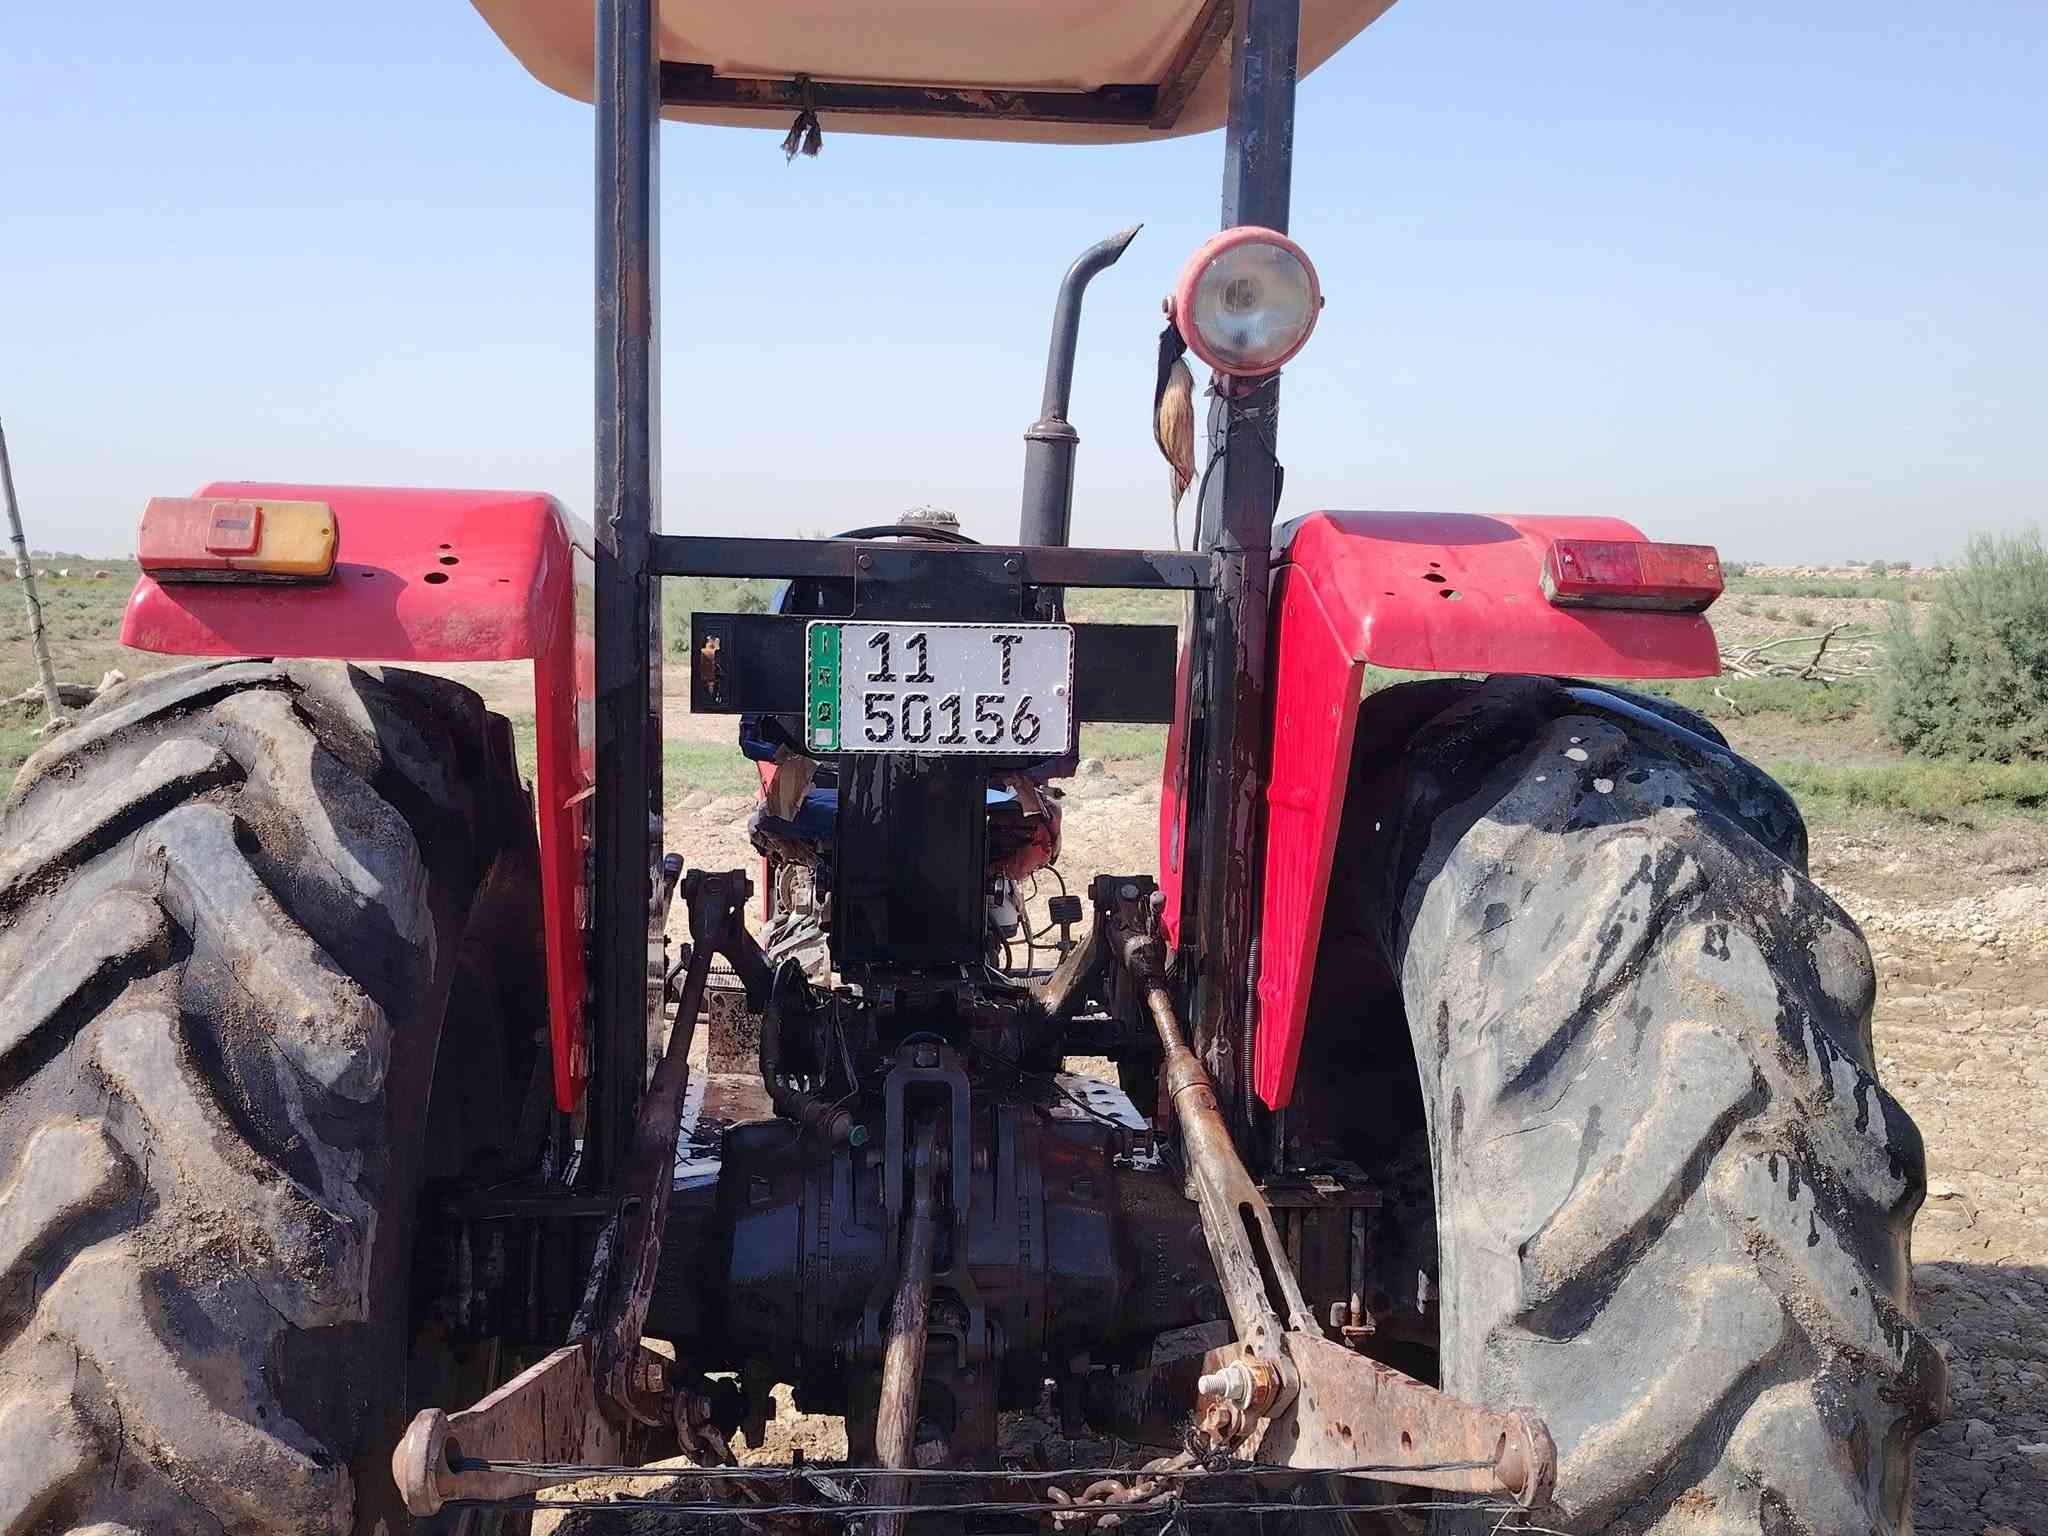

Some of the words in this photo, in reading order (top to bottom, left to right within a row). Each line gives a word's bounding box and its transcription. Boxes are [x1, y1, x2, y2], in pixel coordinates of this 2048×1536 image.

[866, 631, 935, 683] 11
[991, 634, 1024, 686] T
[863, 693, 1042, 746] 50156
